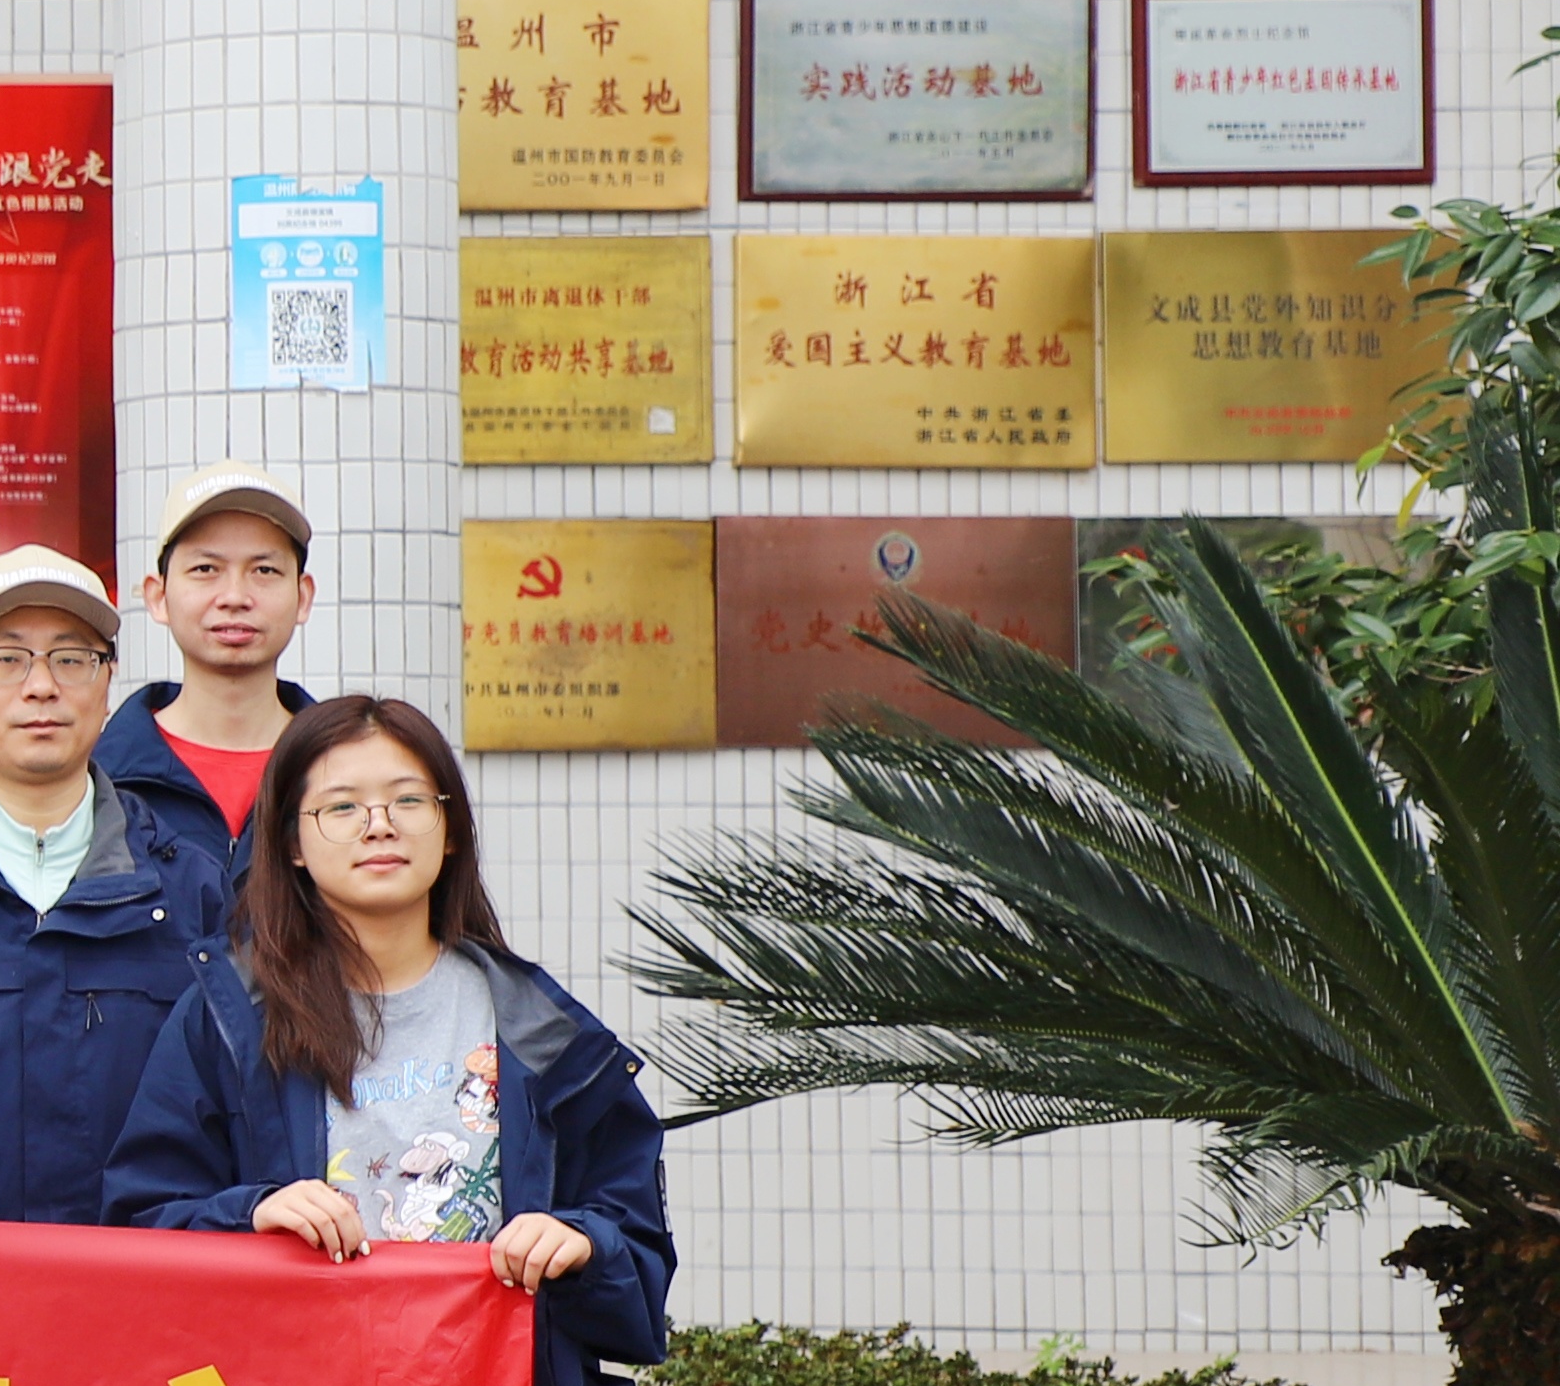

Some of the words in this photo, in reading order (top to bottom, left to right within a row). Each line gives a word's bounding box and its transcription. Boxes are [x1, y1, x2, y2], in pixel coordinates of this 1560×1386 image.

[800, 63, 1044, 101] 实践活动基地
[835, 271, 999, 310] 浙江省
[766, 329, 1071, 369] 爱国主义教育基地
[1192, 330, 1384, 360] 思想教育基地
[916, 429, 1072, 445] 浙江省人民政府
